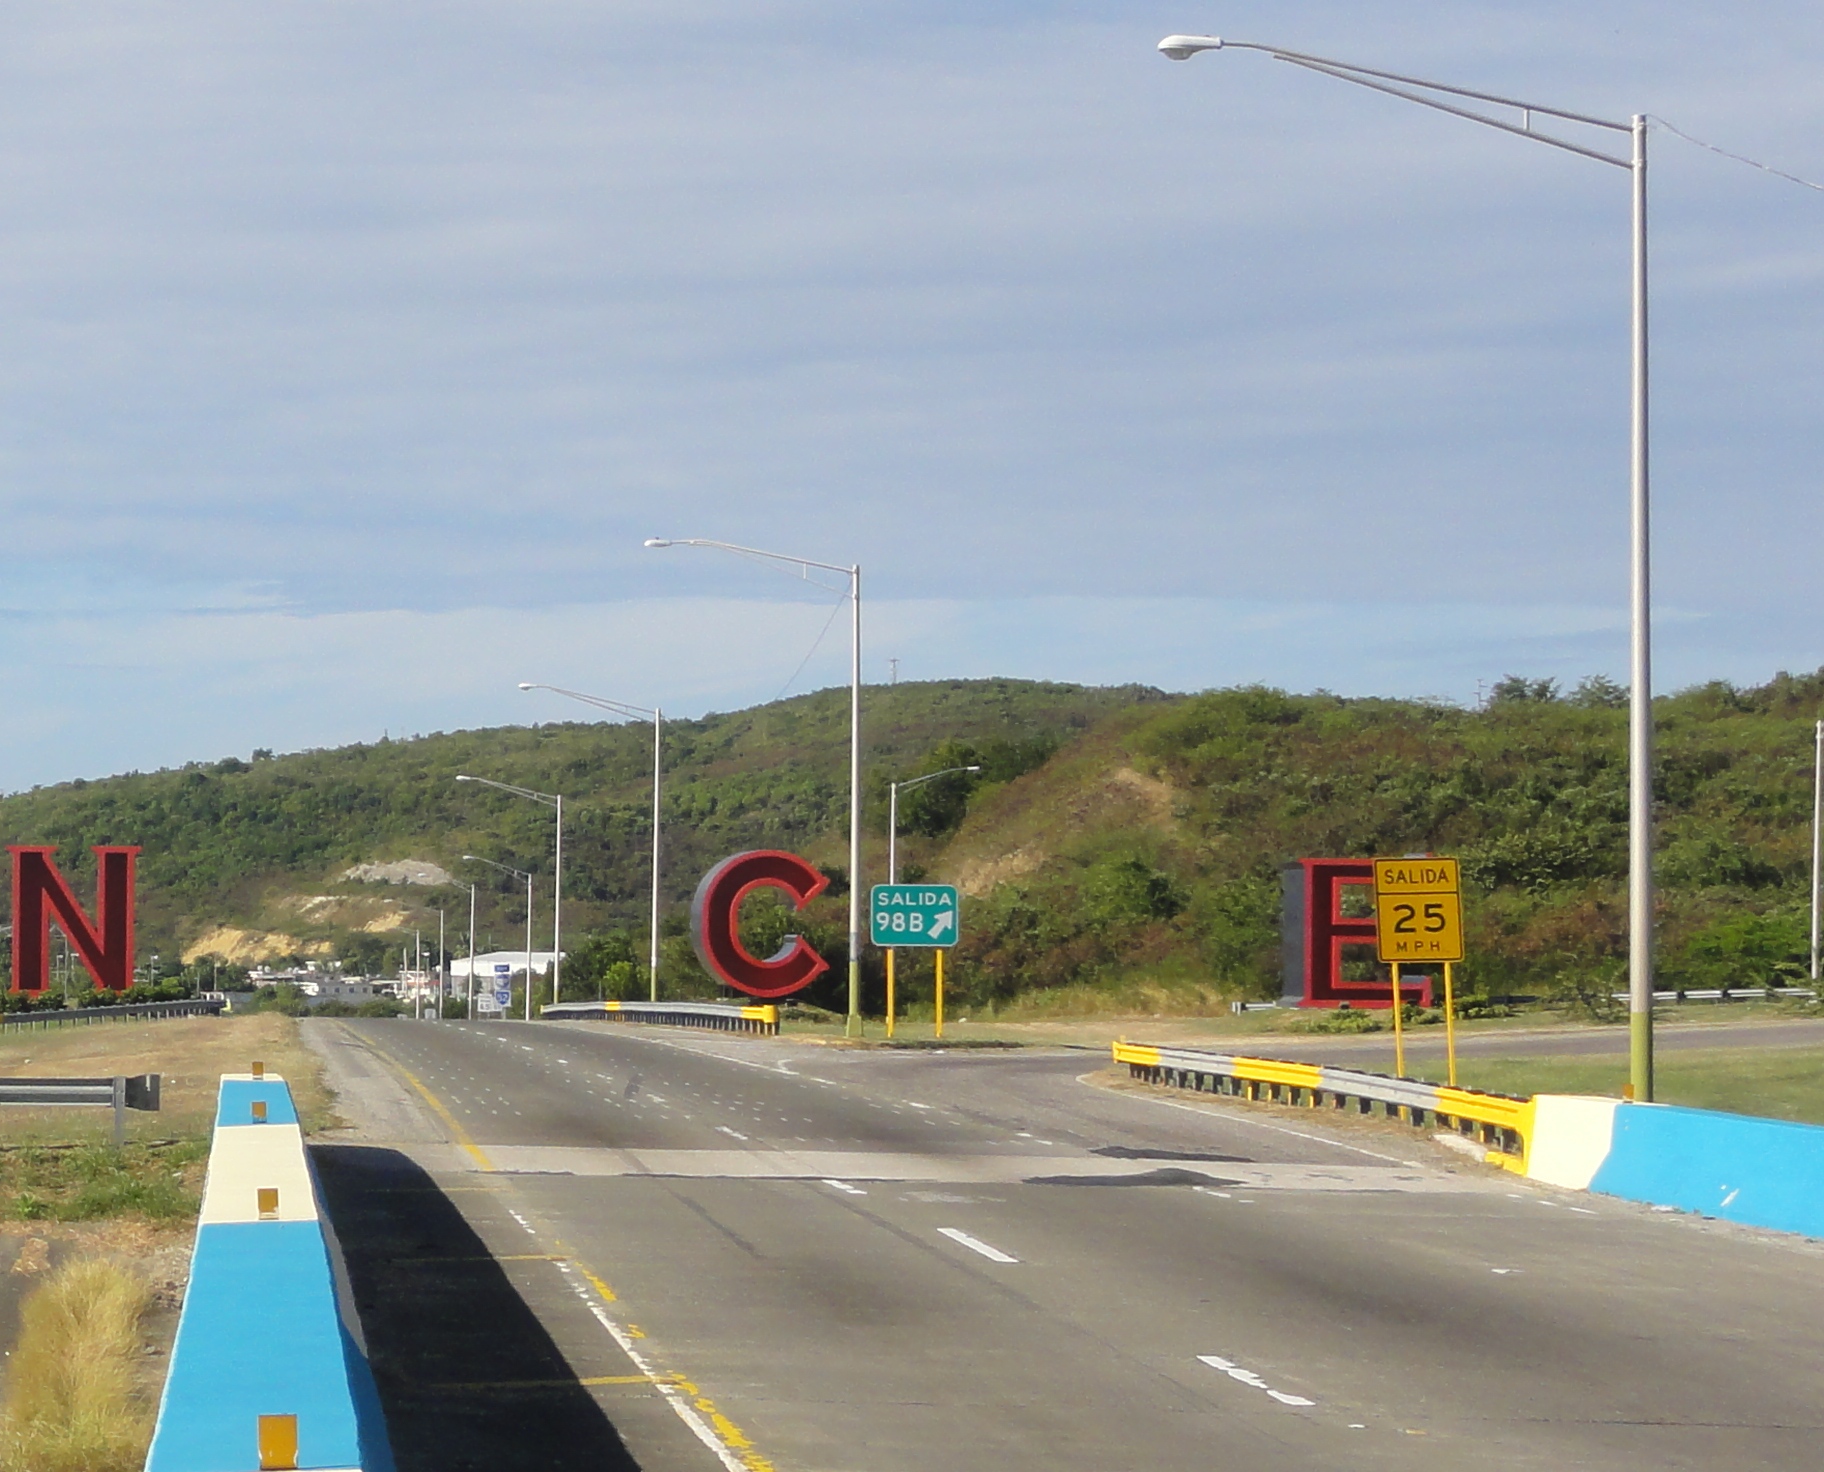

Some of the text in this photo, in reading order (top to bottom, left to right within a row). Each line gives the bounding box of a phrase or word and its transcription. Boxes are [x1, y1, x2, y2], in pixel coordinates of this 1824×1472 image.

[1384, 867, 1449, 885] SALIDA
[878, 892, 952, 906] SALIDA
[876, 912, 923, 932] 98B
[1393, 903, 1446, 933] 25
